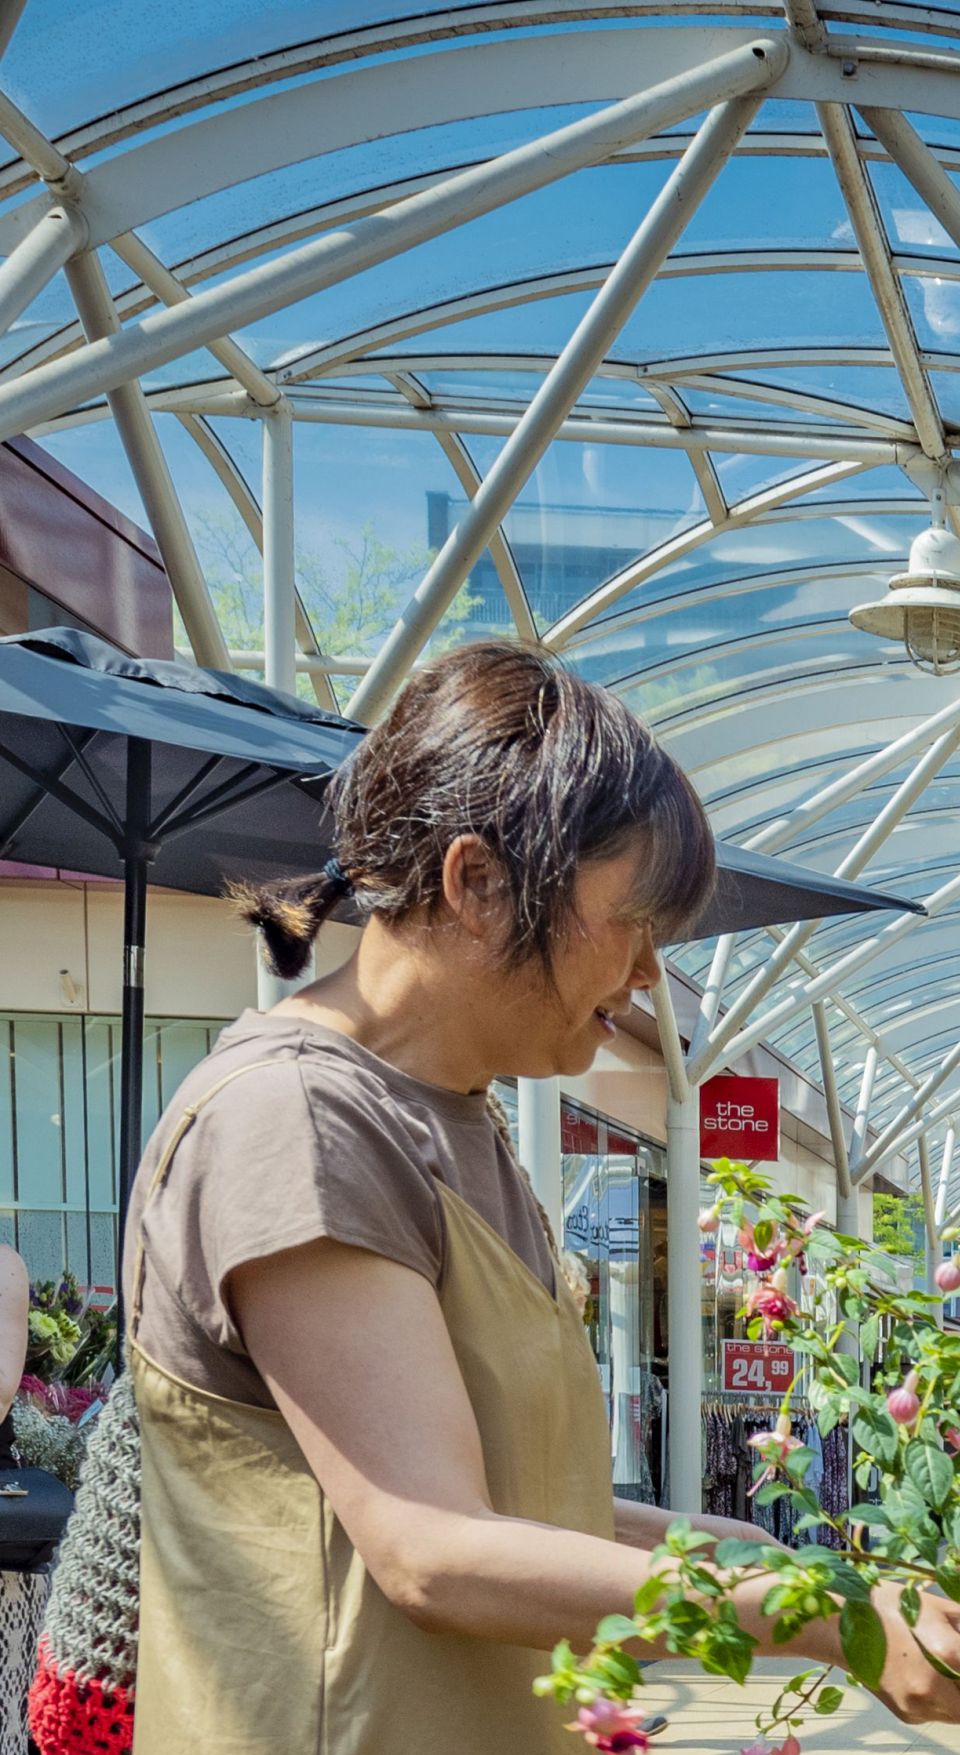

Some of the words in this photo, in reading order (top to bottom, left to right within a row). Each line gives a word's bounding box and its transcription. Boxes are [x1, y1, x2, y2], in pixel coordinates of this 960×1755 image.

[715, 1101, 755, 1117] the
[703, 1117, 769, 1132] stone
[726, 1343, 751, 1353] the
